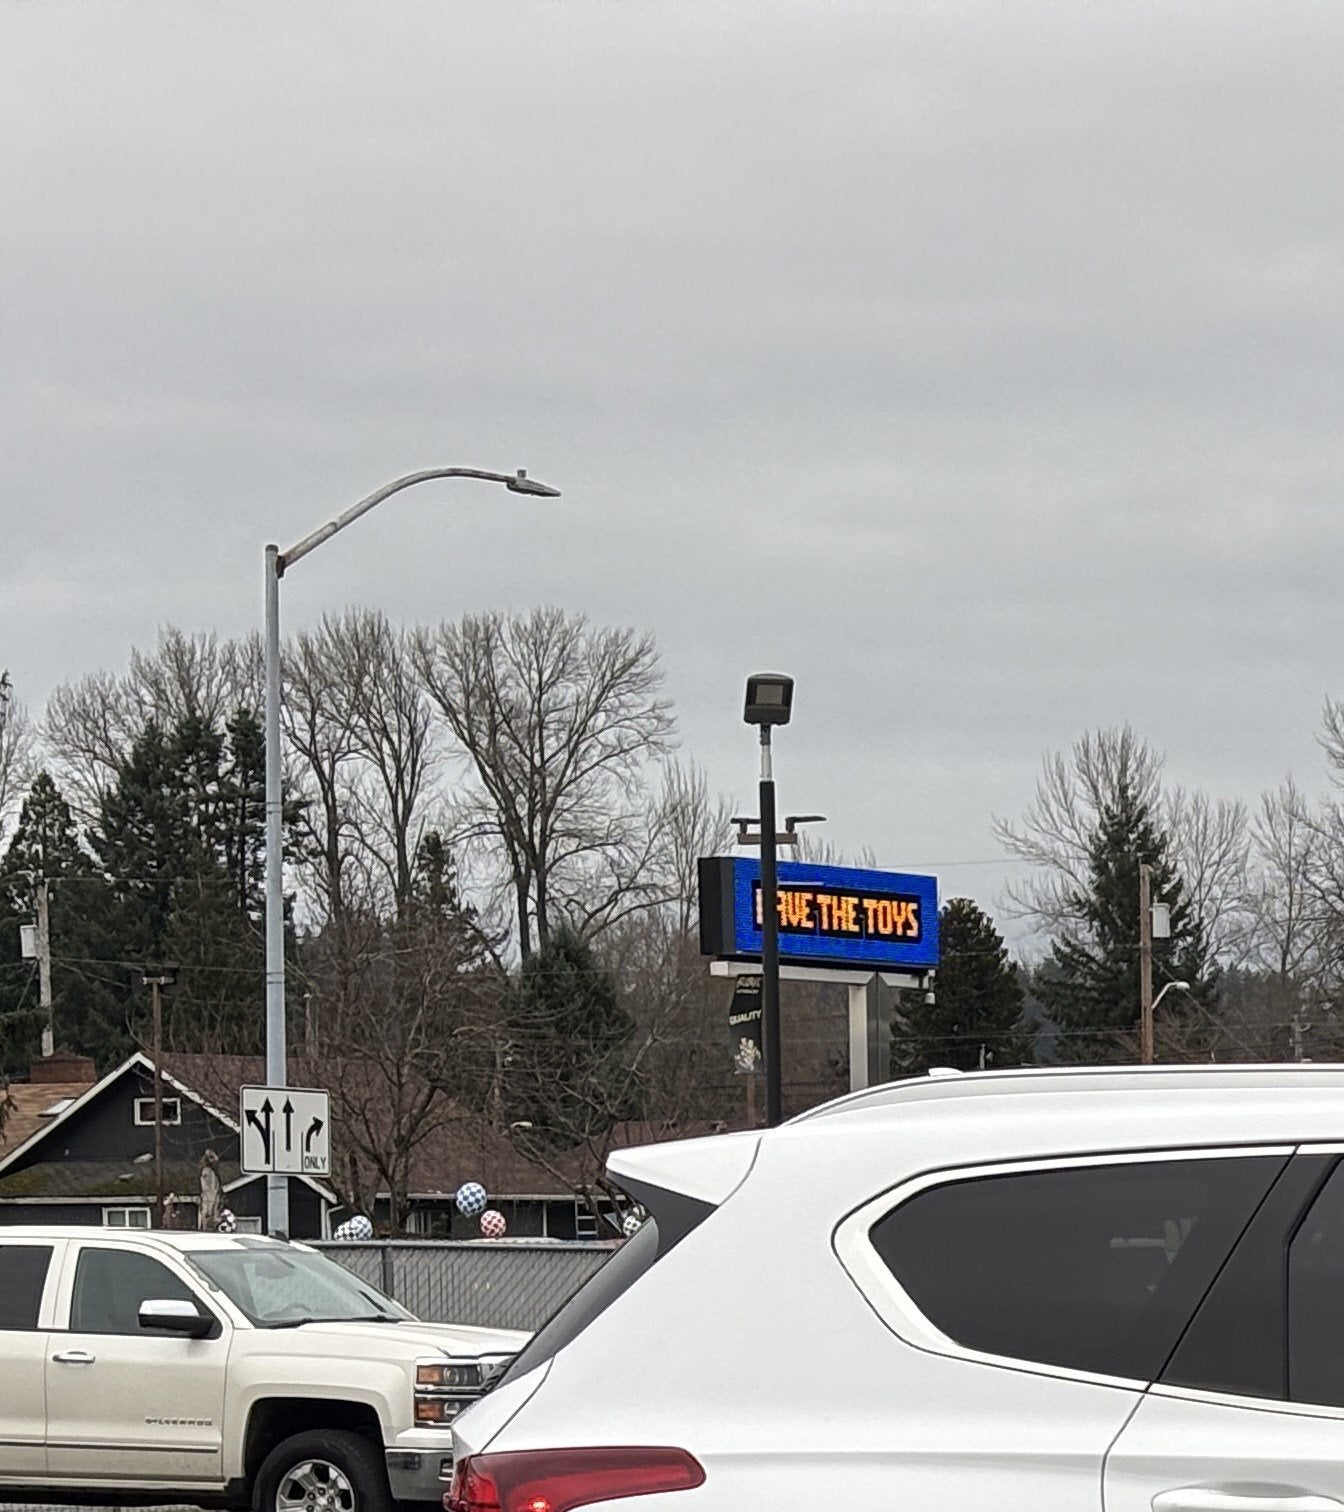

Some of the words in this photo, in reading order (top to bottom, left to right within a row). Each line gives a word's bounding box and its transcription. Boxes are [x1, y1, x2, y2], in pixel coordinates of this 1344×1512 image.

[817, 894, 860, 932] THE
[863, 898, 919, 937] TOYS
[304, 1155, 327, 1170] ONLY
